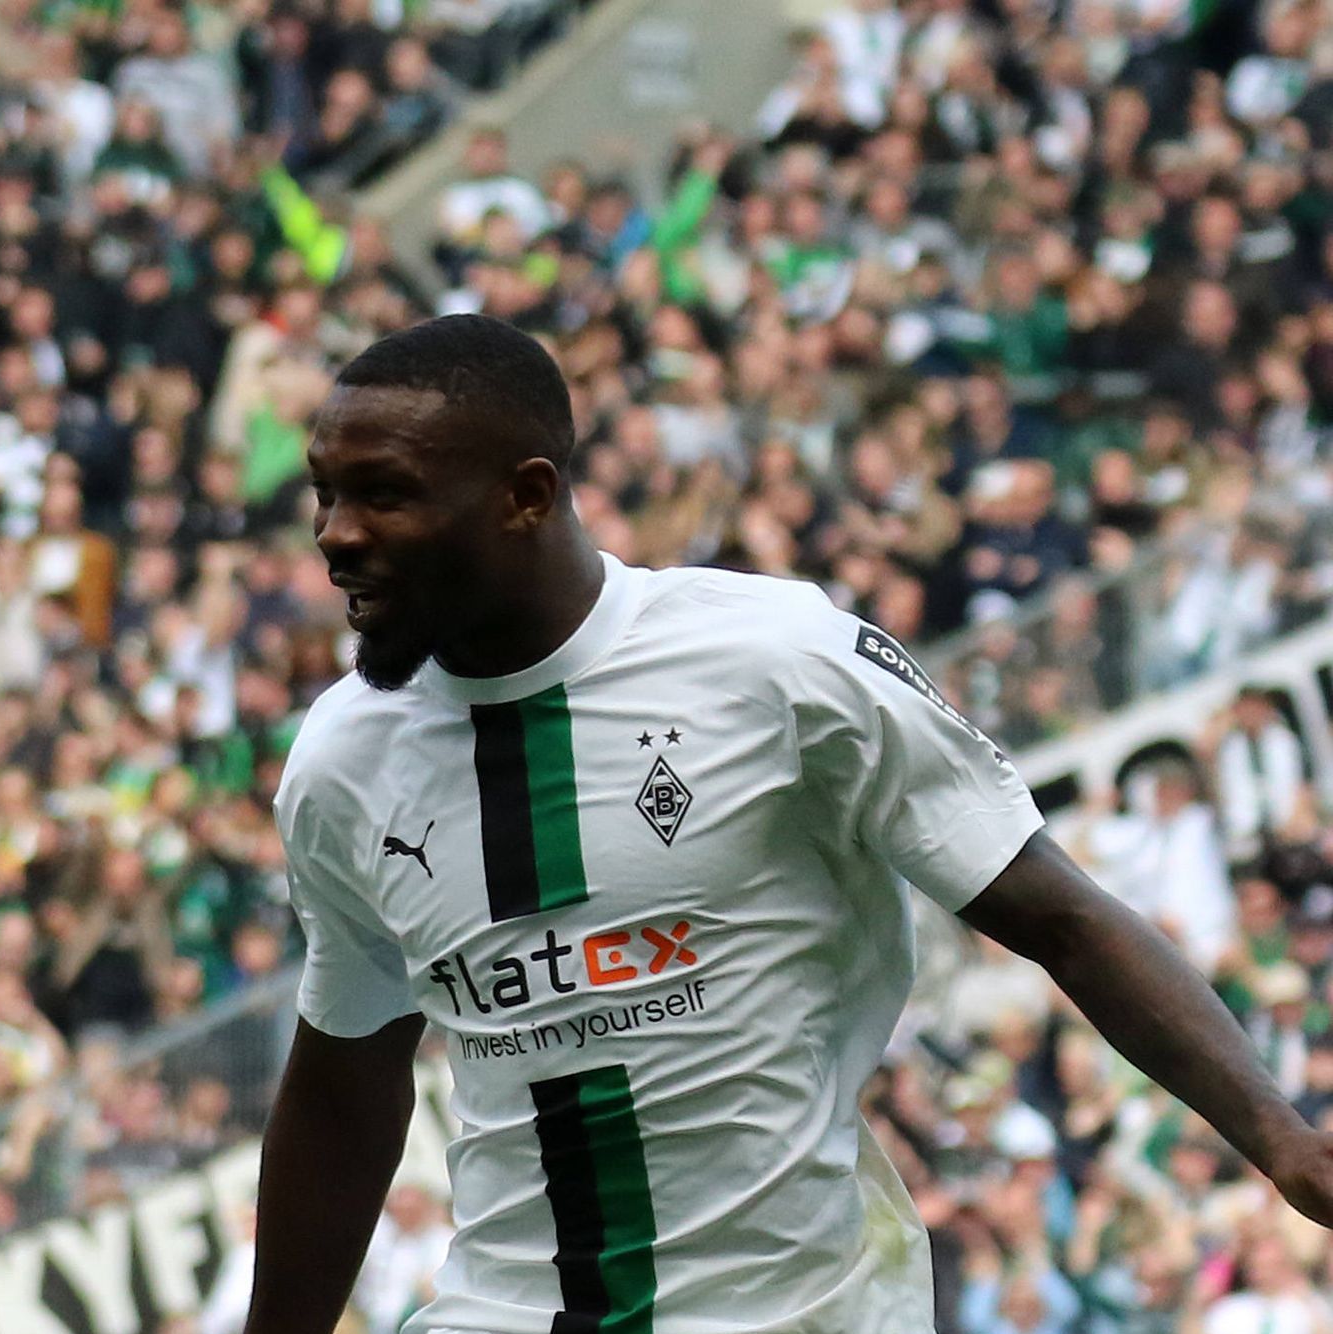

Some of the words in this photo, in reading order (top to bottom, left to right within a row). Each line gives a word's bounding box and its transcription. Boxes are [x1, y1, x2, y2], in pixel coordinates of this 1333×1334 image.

[458, 1025, 528, 1061] Invest
[531, 1021, 564, 1051] in
[567, 978, 707, 1049] yourself
